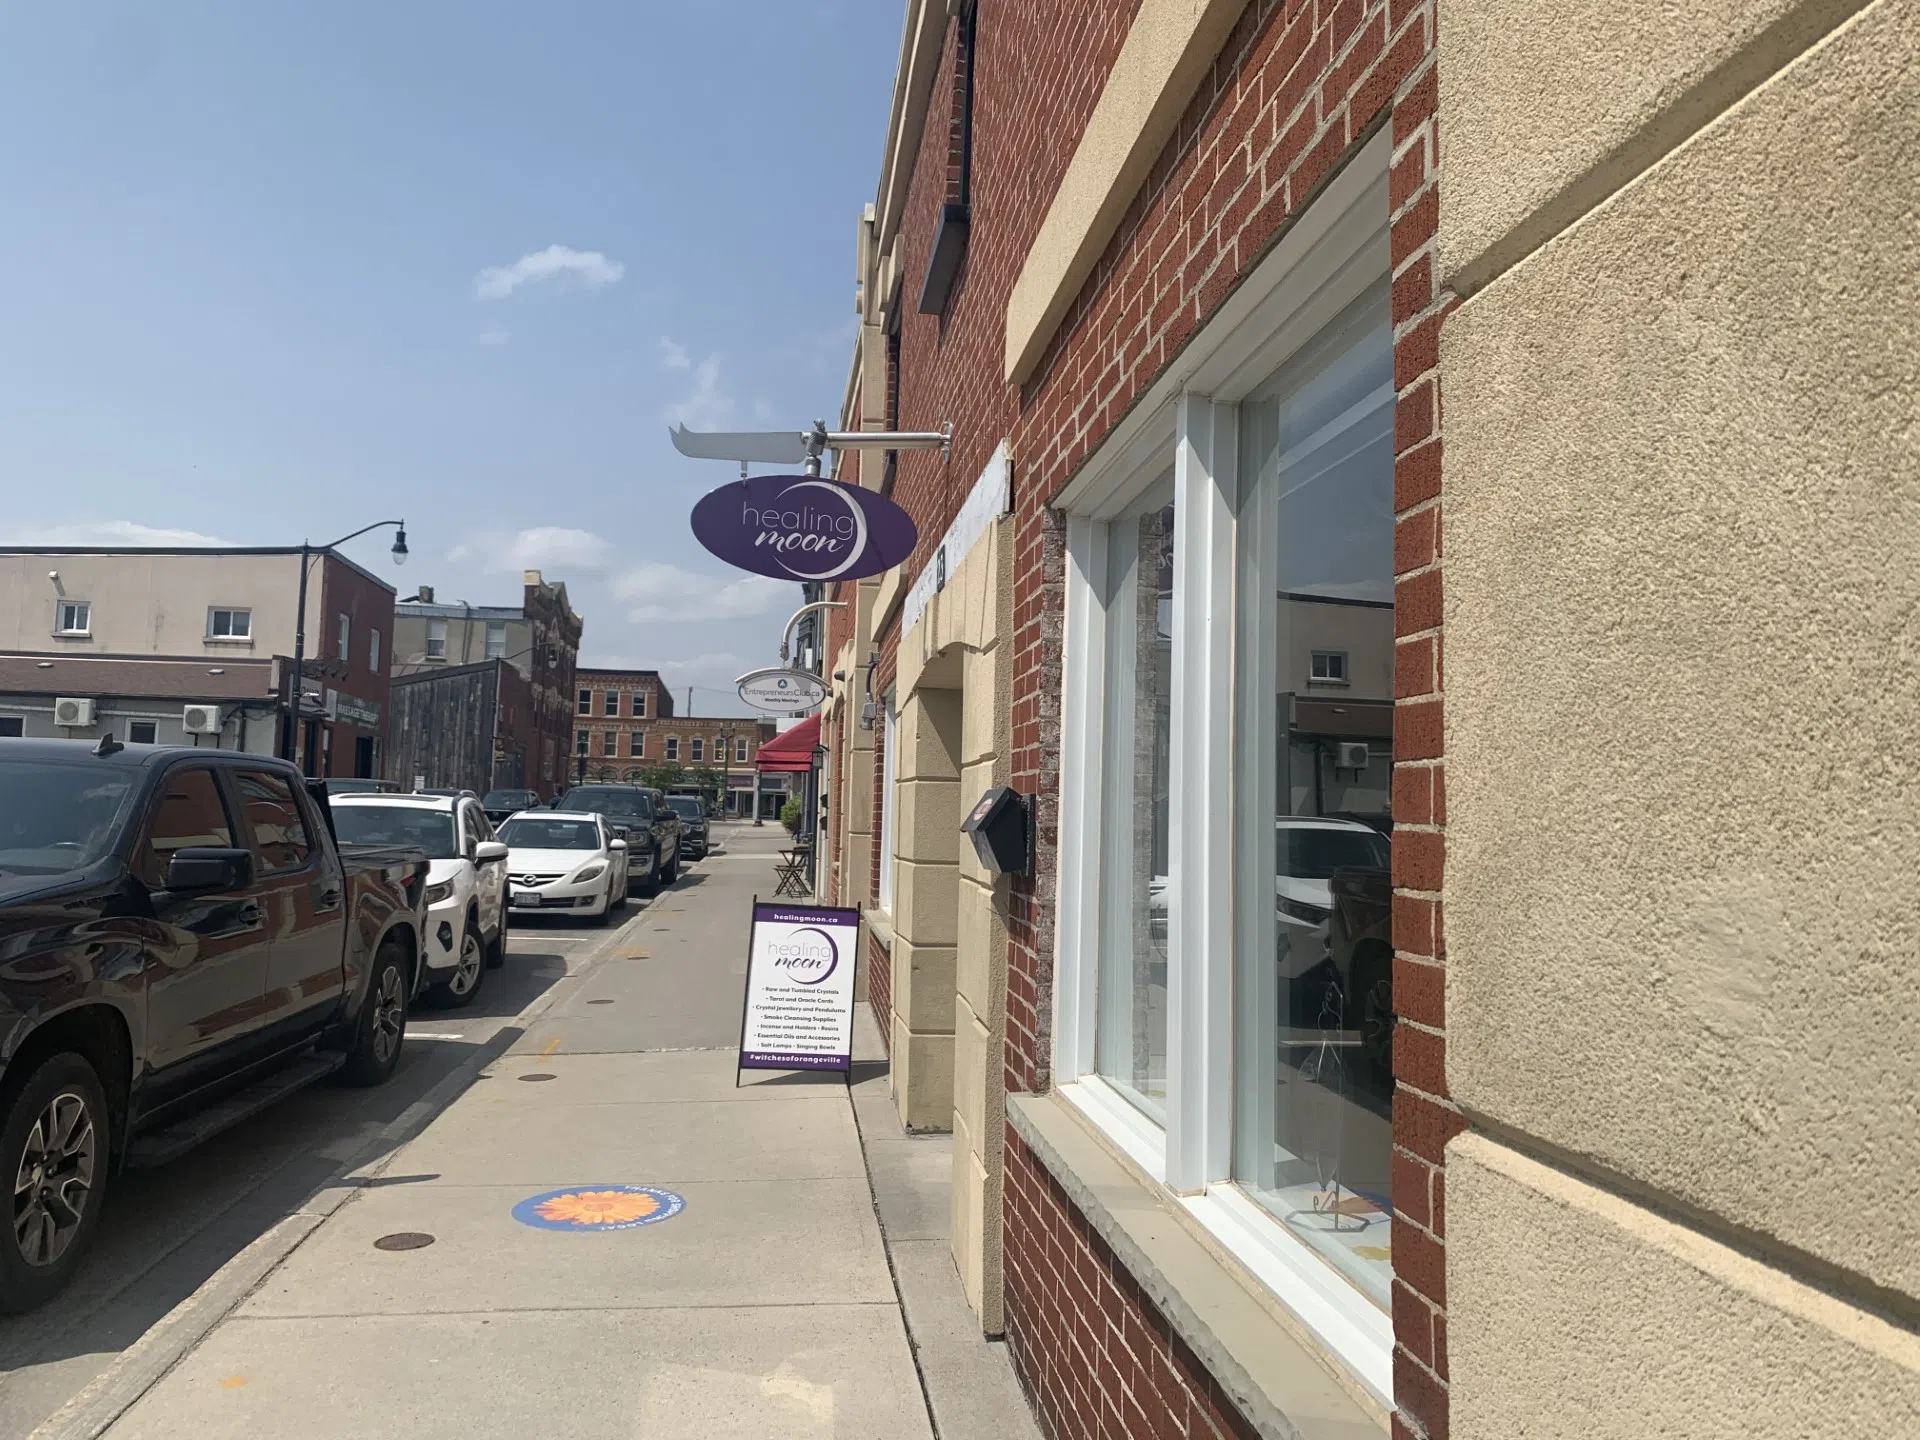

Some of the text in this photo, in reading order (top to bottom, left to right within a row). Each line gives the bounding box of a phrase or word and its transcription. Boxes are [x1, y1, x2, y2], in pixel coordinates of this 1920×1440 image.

[743, 501, 854, 540] healing
[755, 530, 844, 553] moon
[744, 688, 820, 696] EntrepreneursClub.ca
[774, 914, 838, 923] healingmoon.ca
[768, 940, 831, 961] healing
[775, 957, 824, 970] moon
[750, 1054, 841, 1064] #witchesoforangeville
